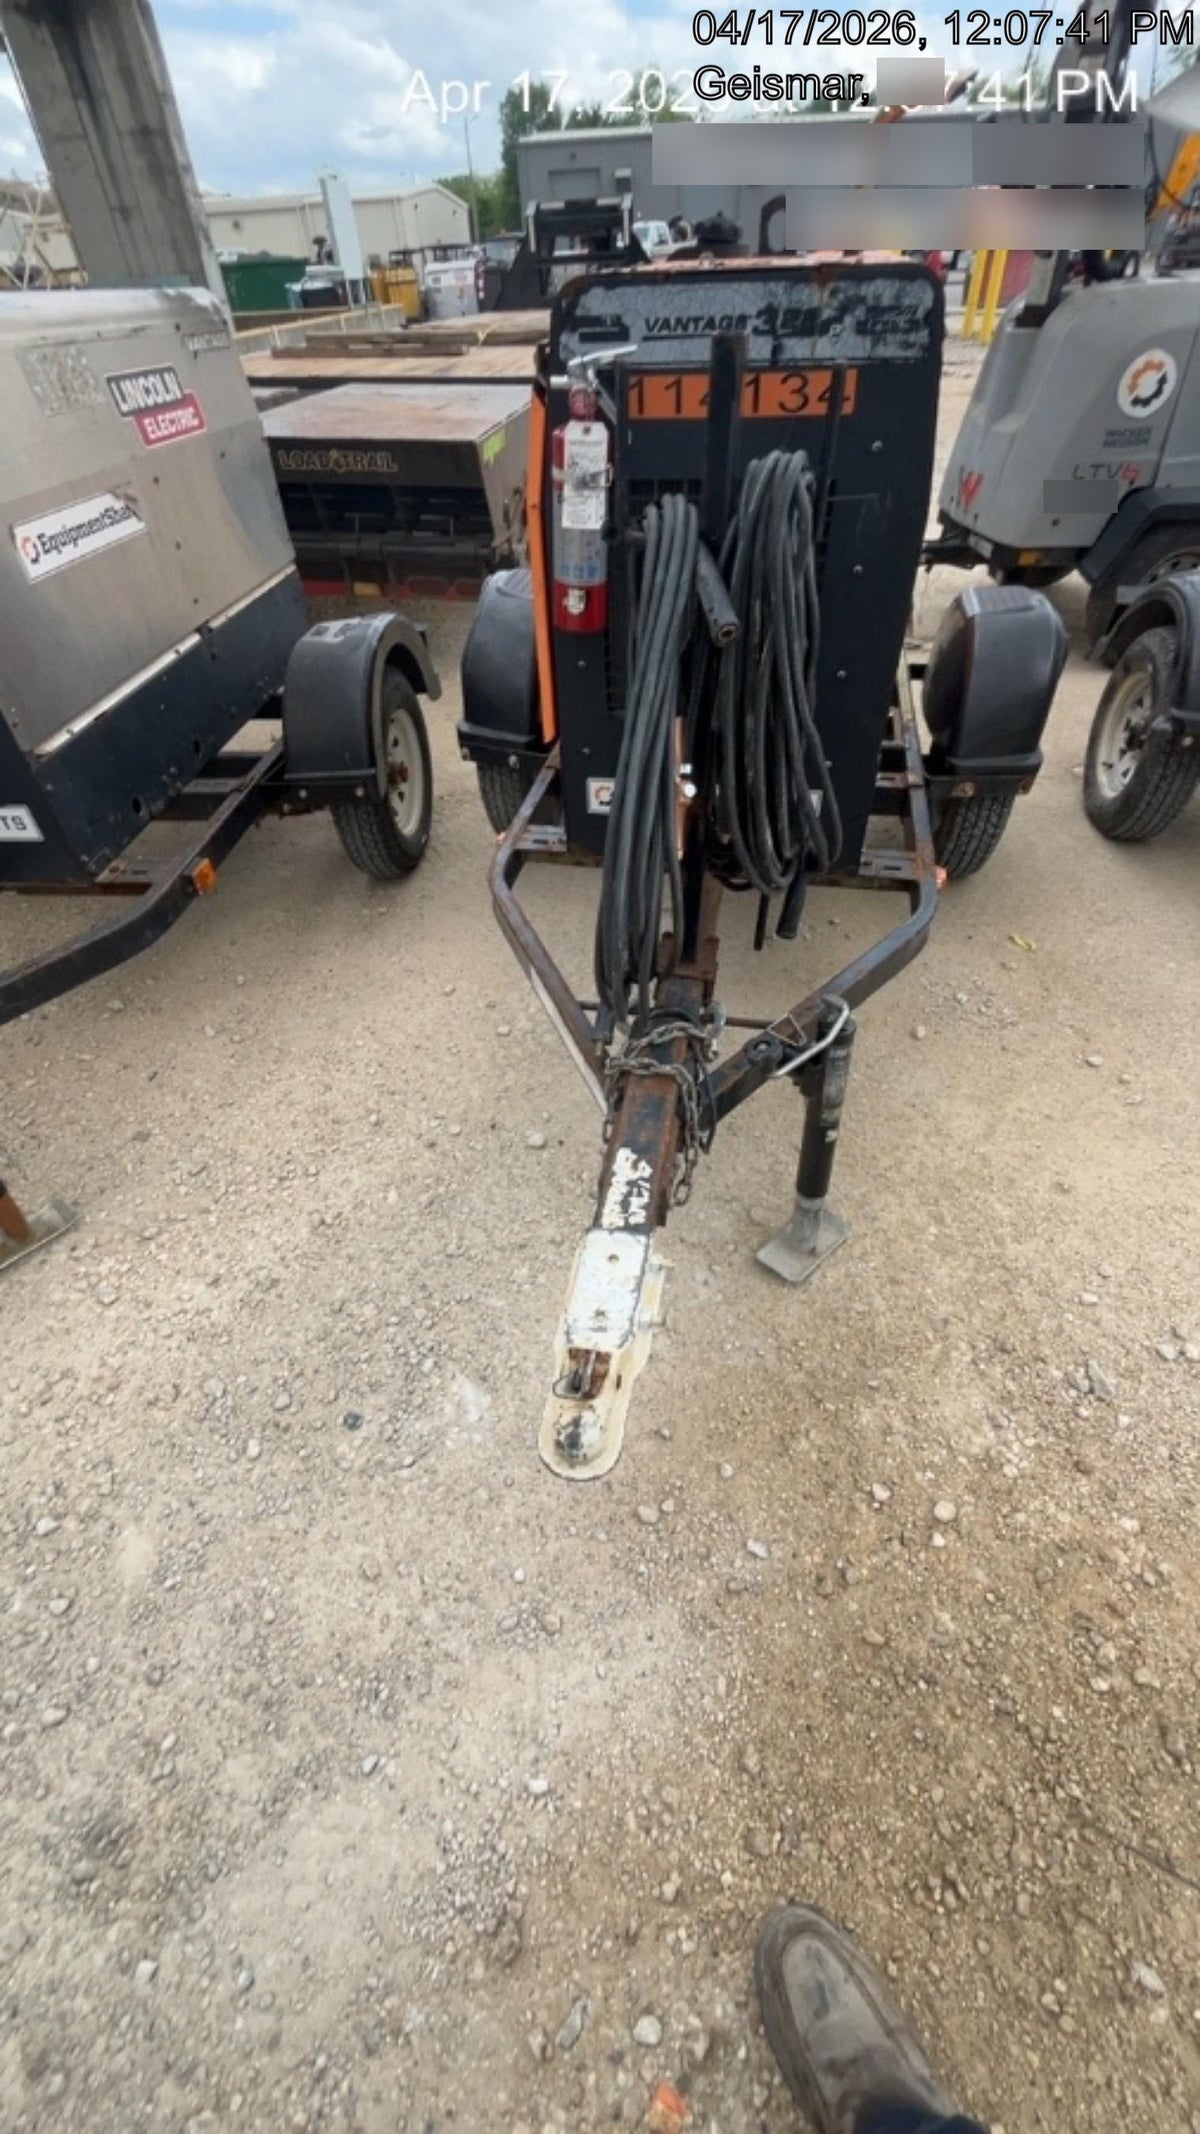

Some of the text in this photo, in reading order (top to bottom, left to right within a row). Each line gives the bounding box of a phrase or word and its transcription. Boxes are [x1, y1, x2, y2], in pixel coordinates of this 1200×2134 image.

[643, 314, 748, 333] VANTAGE
[110, 371, 183, 413] LINCOLN
[144, 406, 200, 440] ELECTRIC
